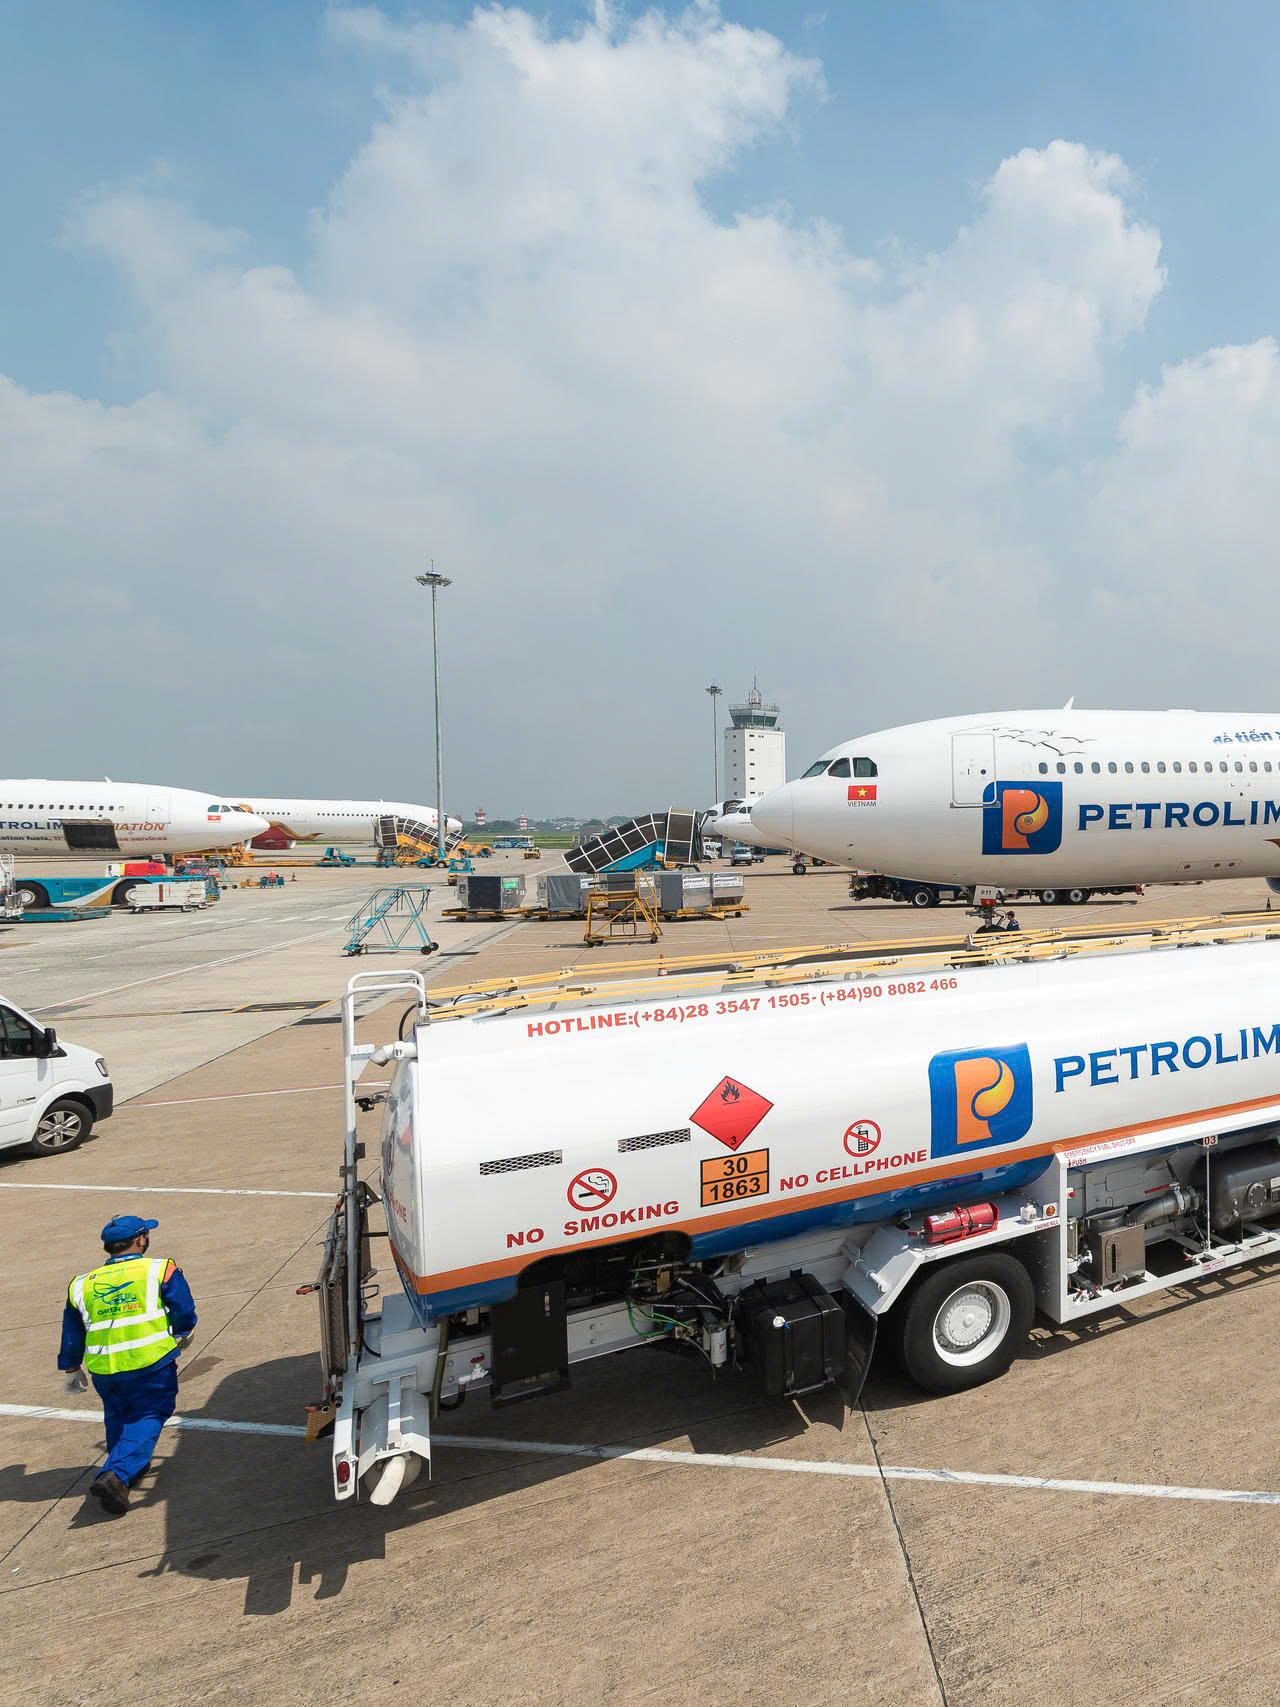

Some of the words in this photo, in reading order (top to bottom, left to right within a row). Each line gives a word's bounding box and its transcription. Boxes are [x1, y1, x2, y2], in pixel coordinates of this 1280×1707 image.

[716, 997, 761, 1015] 3547
[887, 980, 926, 996] 8082
[930, 977, 958, 991] 466
[730, 1135, 738, 1145] 3
[1204, 1136, 1216, 1145] 03
[723, 1157, 749, 1176] 30
[779, 1173, 810, 1191] NO
[815, 1149, 928, 1181] CELLPHONE
[1072, 1158, 1087, 1166] PUSH
[709, 1178, 761, 1201] 1863
[506, 1228, 544, 1249] NO
[563, 1200, 680, 1237] SMOKING
